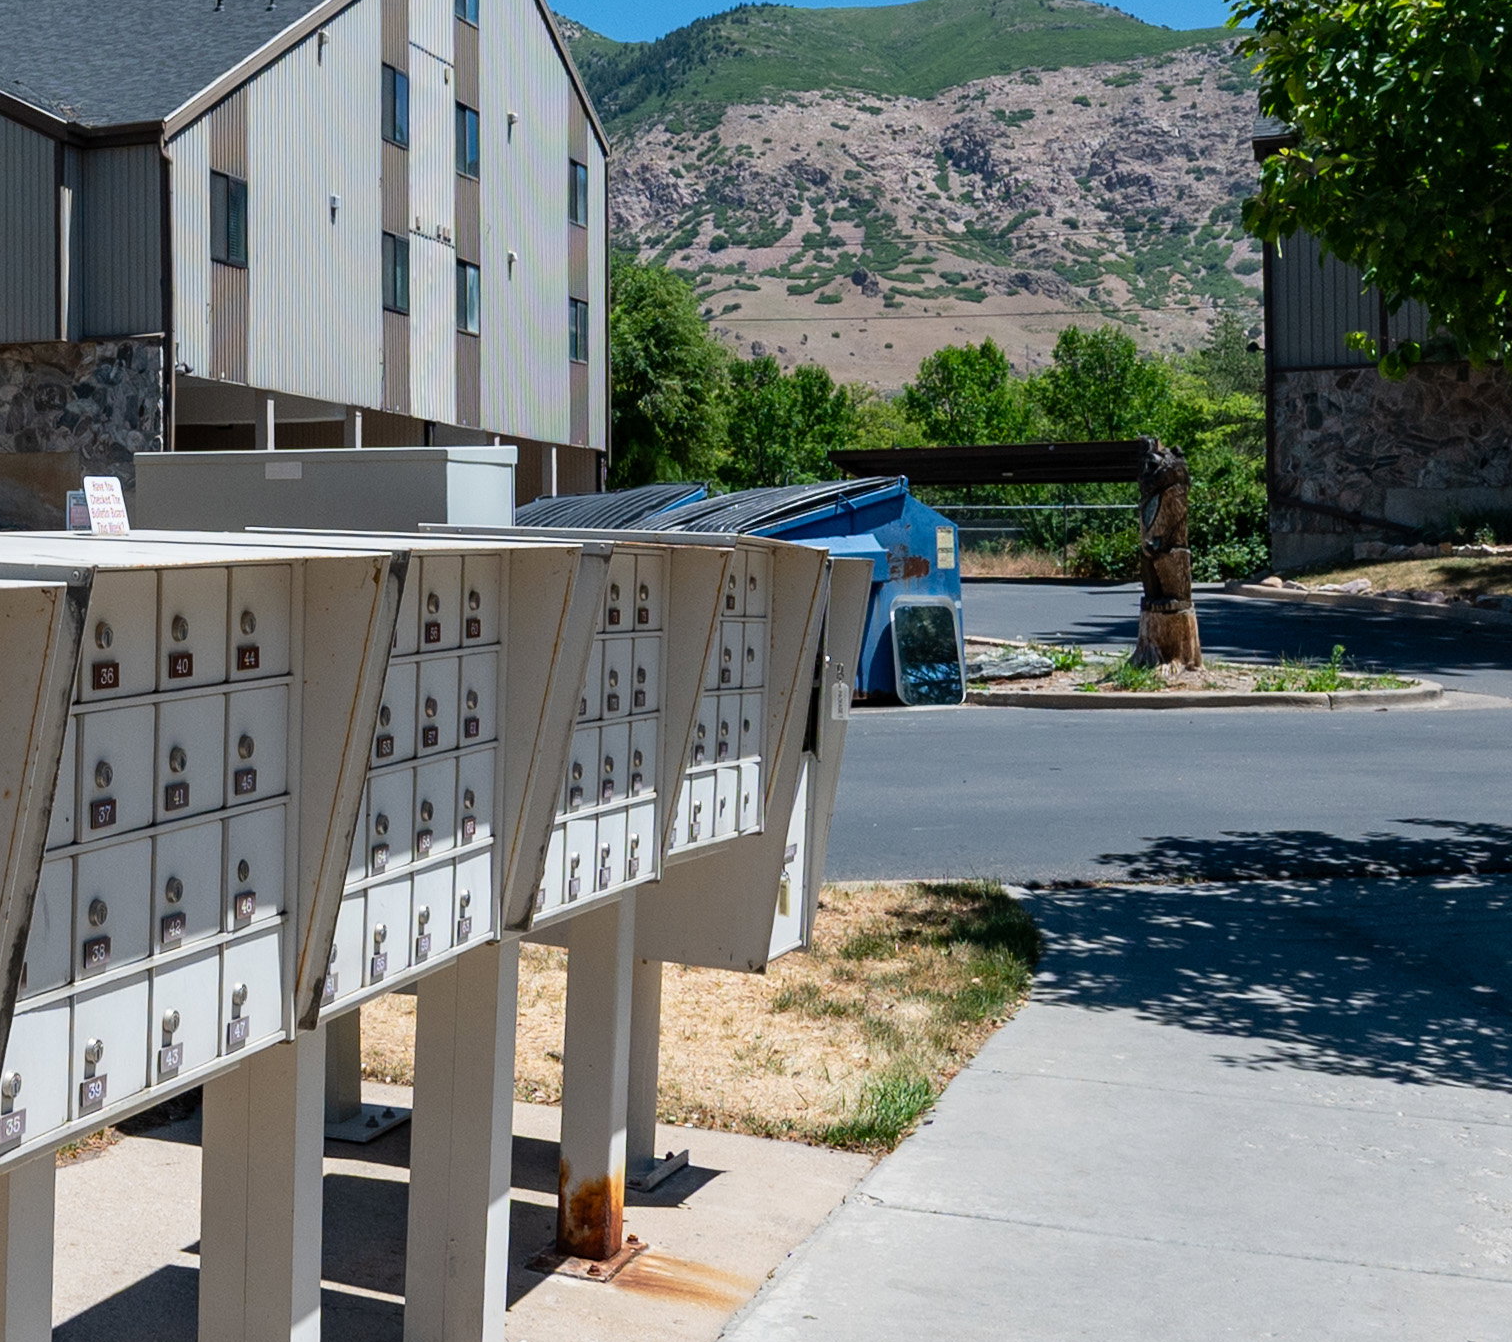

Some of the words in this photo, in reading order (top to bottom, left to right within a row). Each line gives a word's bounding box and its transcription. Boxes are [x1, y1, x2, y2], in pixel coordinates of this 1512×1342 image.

[176, 658, 189, 674] 40
[243, 651, 255, 666] 44
[100, 667, 115, 685] 36
[241, 774, 253, 791] 45
[173, 788, 184, 805] 41
[98, 805, 112, 824] 37
[241, 897, 253, 913] 46
[168, 920, 182, 937] 42
[92, 943, 106, 963] 38
[233, 1020, 246, 1038] 47
[165, 1048, 179, 1067] 43
[88, 1081, 103, 1099] 39
[5, 1116, 21, 1137] 35
